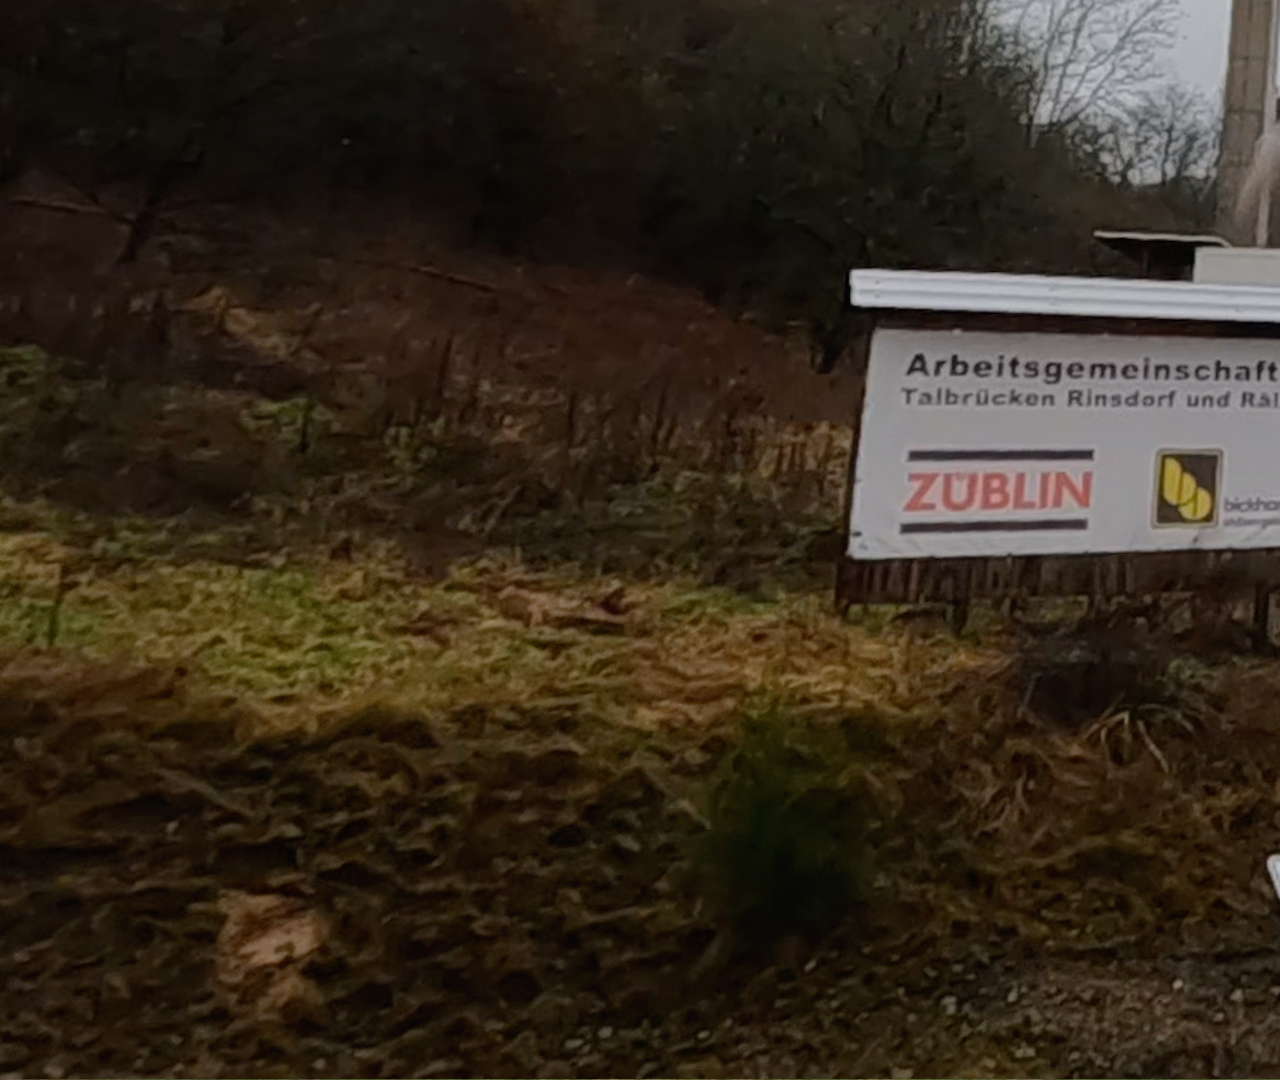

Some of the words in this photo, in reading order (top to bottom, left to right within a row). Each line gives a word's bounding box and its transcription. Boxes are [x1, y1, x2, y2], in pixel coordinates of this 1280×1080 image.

[905, 353, 1279, 384] Arbeitsgemeinschaft
[901, 387, 1056, 407] Talbrücken
[1066, 389, 1176, 408] Rinsdorf
[1187, 391, 1231, 409] und
[903, 471, 1093, 512] ZÜBLIN
